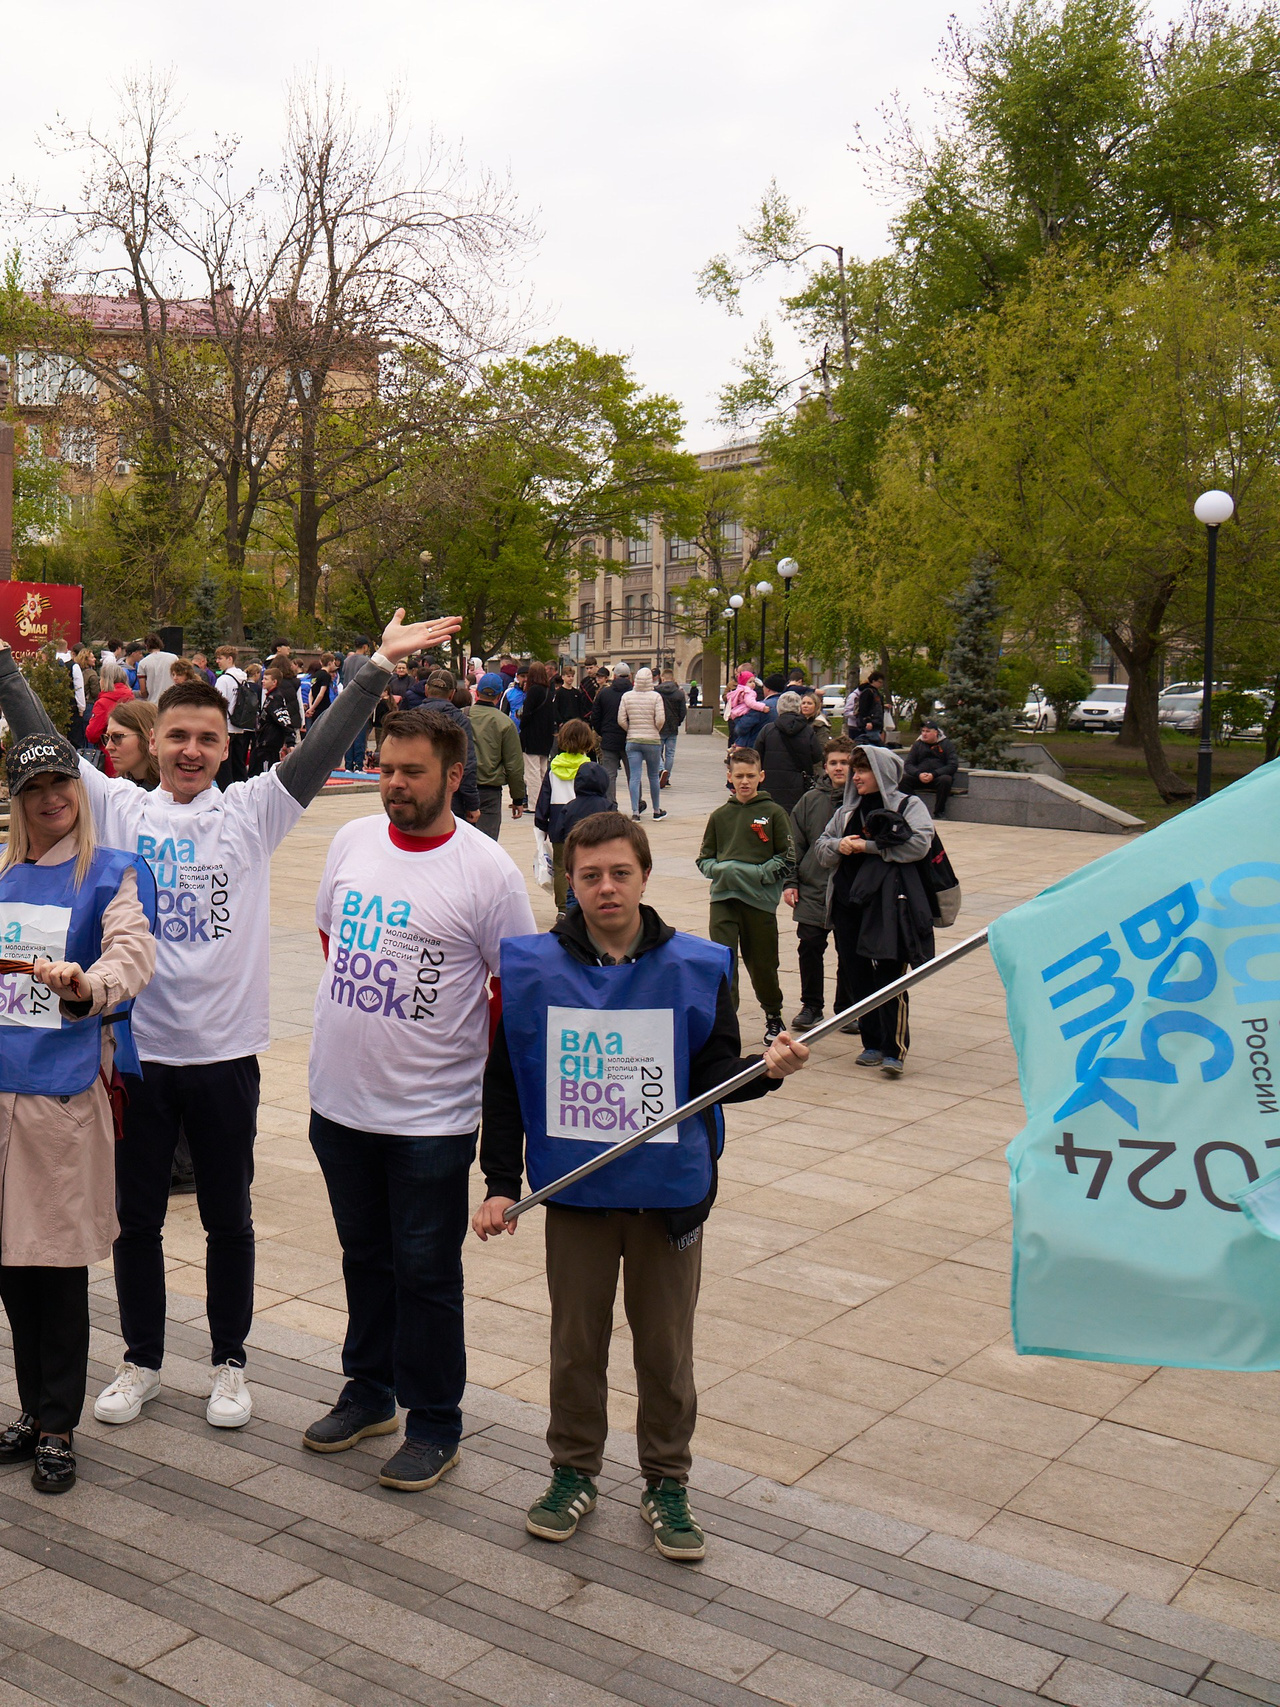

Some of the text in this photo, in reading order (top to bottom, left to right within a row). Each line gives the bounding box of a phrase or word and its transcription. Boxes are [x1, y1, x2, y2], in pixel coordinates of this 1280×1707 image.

[20, 745, 57, 764] GUCCI
[179, 882, 206, 890] России
[211, 873, 232, 940] 2024
[383, 938, 419, 952] столица
[385, 928, 441, 946] молодёжная
[380, 947, 412, 960] России
[410, 948, 445, 1021] 2024
[1241, 1018, 1279, 1114] России
[1055, 1132, 1280, 1212] 024
